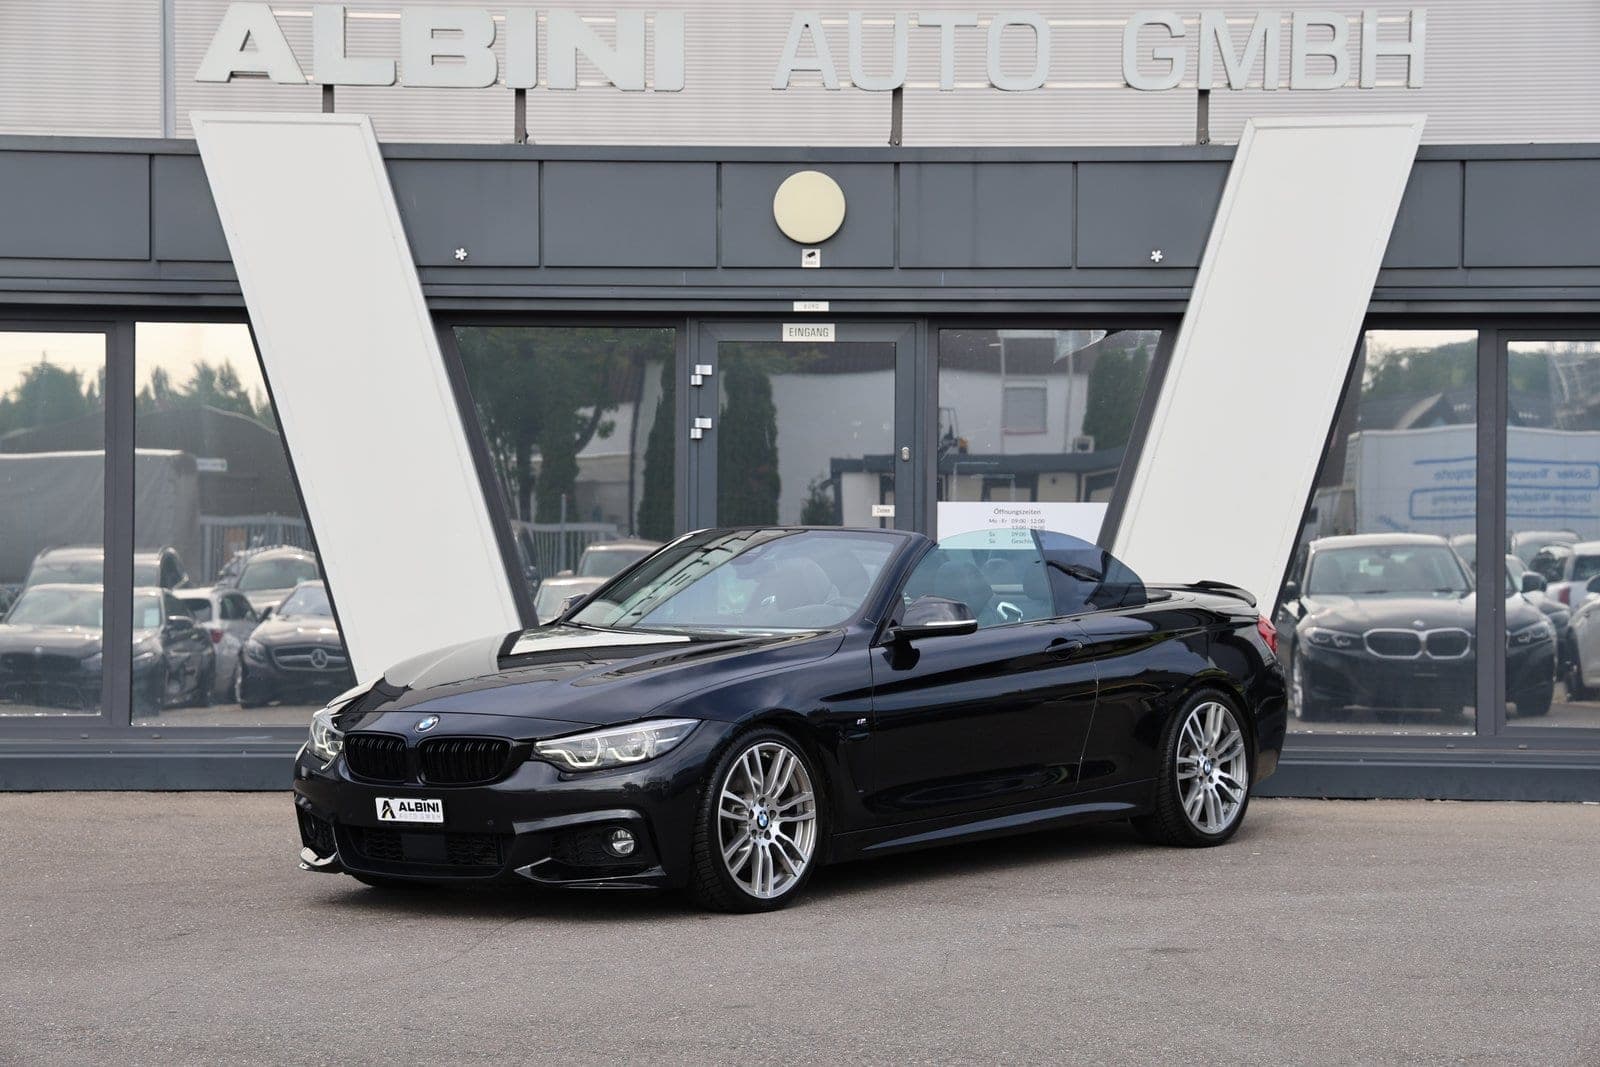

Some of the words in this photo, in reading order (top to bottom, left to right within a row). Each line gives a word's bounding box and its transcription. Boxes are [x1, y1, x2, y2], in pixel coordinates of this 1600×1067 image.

[194, 1, 686, 92] ALBINI
[771, 10, 1051, 91] AUTO
[1120, 8, 1427, 91] GMBH
[788, 327, 829, 337] EINGANG
[398, 801, 440, 813] ALBINI
